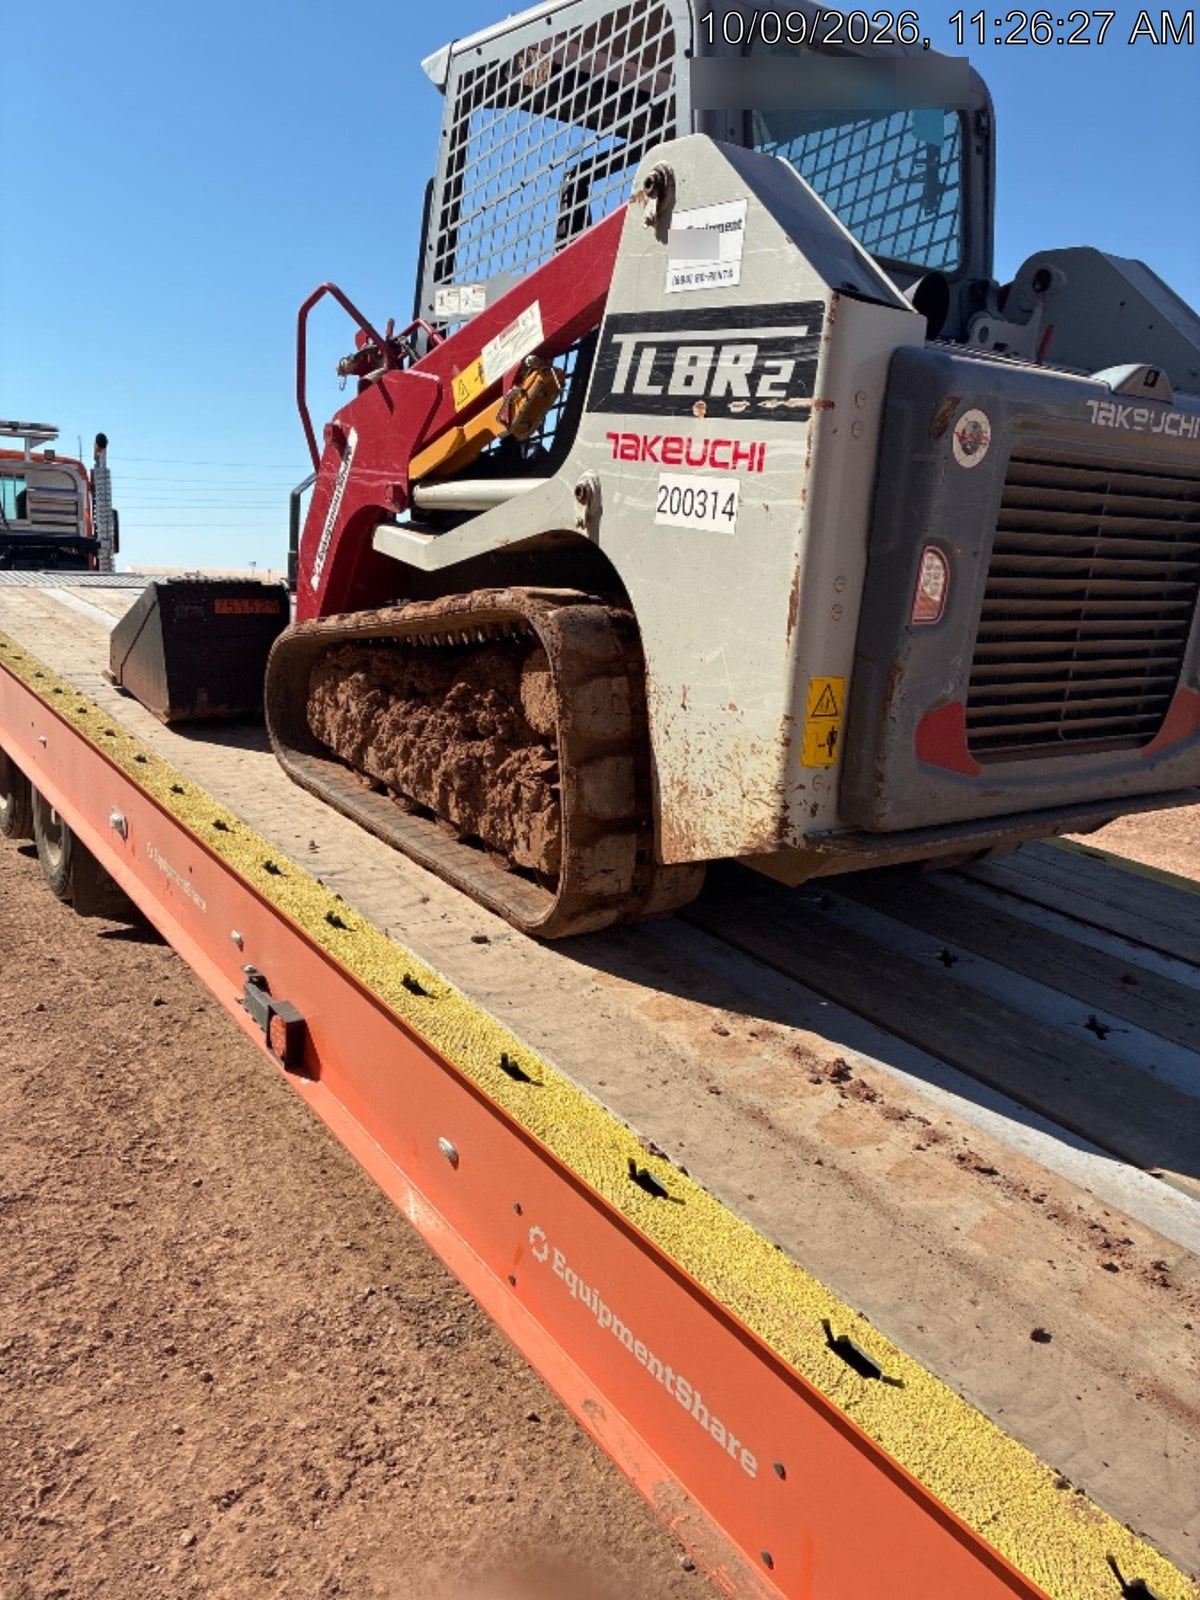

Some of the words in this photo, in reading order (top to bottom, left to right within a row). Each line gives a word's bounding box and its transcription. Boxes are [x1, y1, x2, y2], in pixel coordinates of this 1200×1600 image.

[611, 325, 808, 398] TL8R2
[657, 485, 736, 522] 200314
[552, 1246, 758, 1479] EquipmentShare
